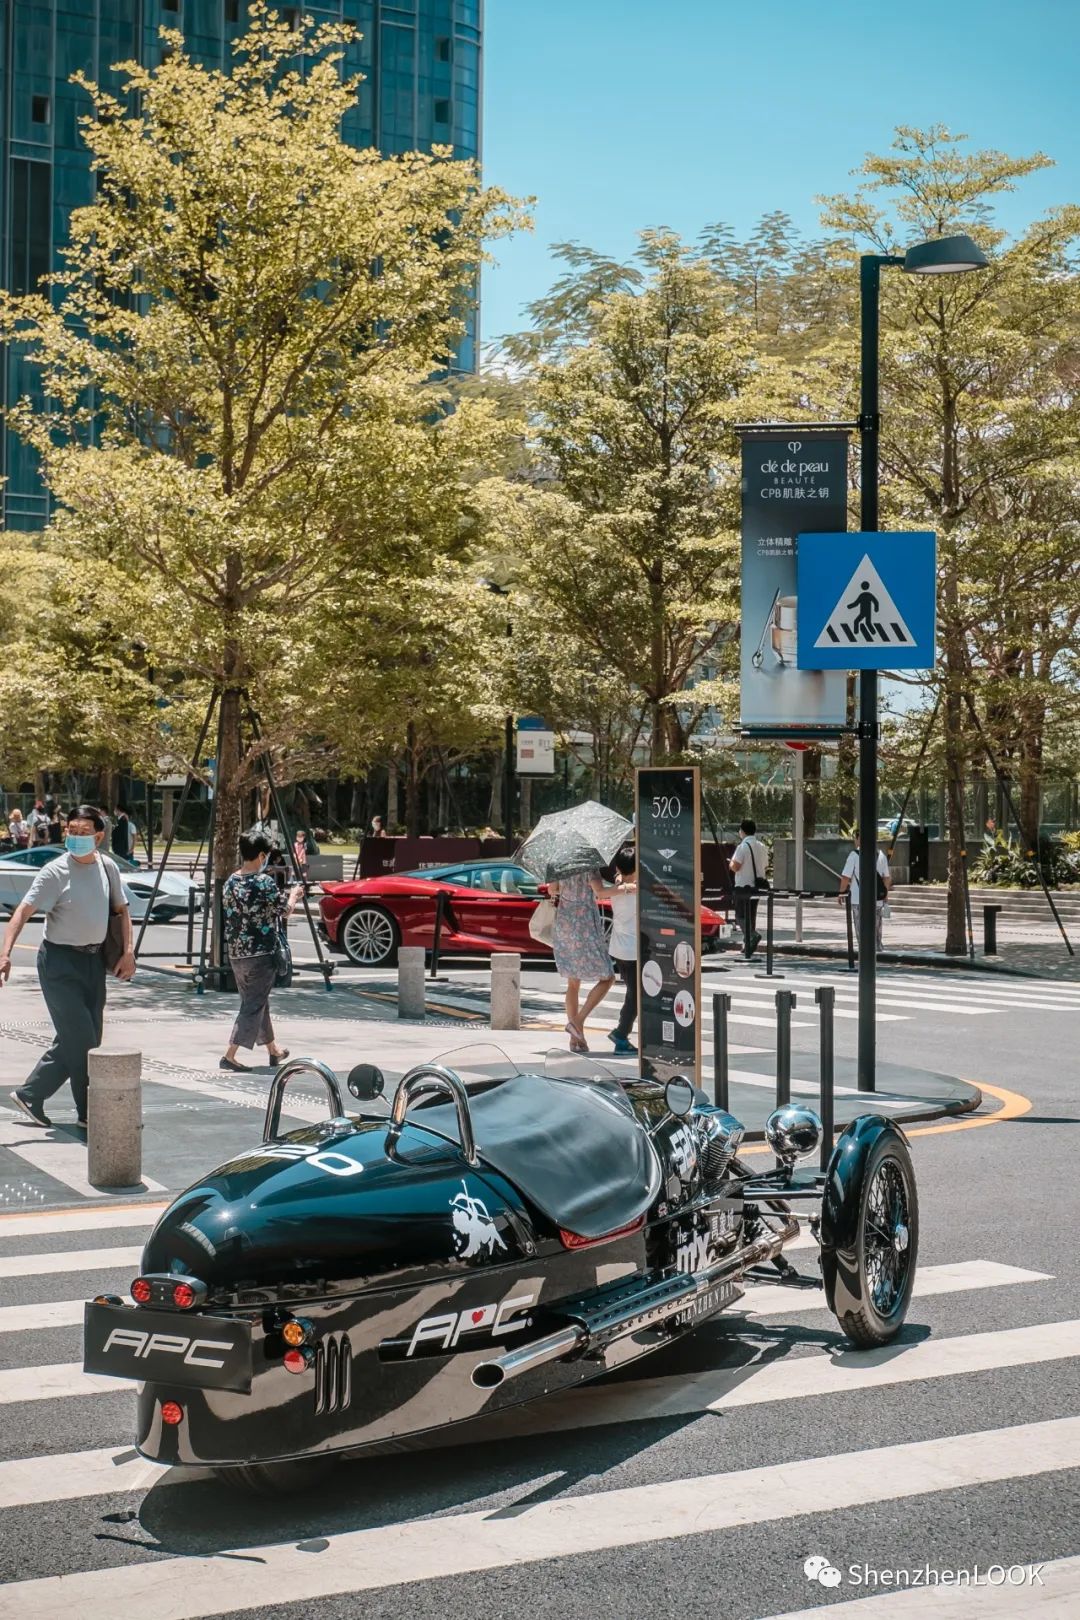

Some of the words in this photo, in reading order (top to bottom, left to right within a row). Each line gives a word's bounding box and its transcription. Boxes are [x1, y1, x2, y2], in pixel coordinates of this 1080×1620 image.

[760, 459, 778, 473] clé
[780, 459, 797, 473] de
[799, 463, 829, 476] peau
[760, 487, 829, 499] CPB肌肤之钥
[651, 796, 681, 819] 520
[102, 1328, 234, 1369] APC
